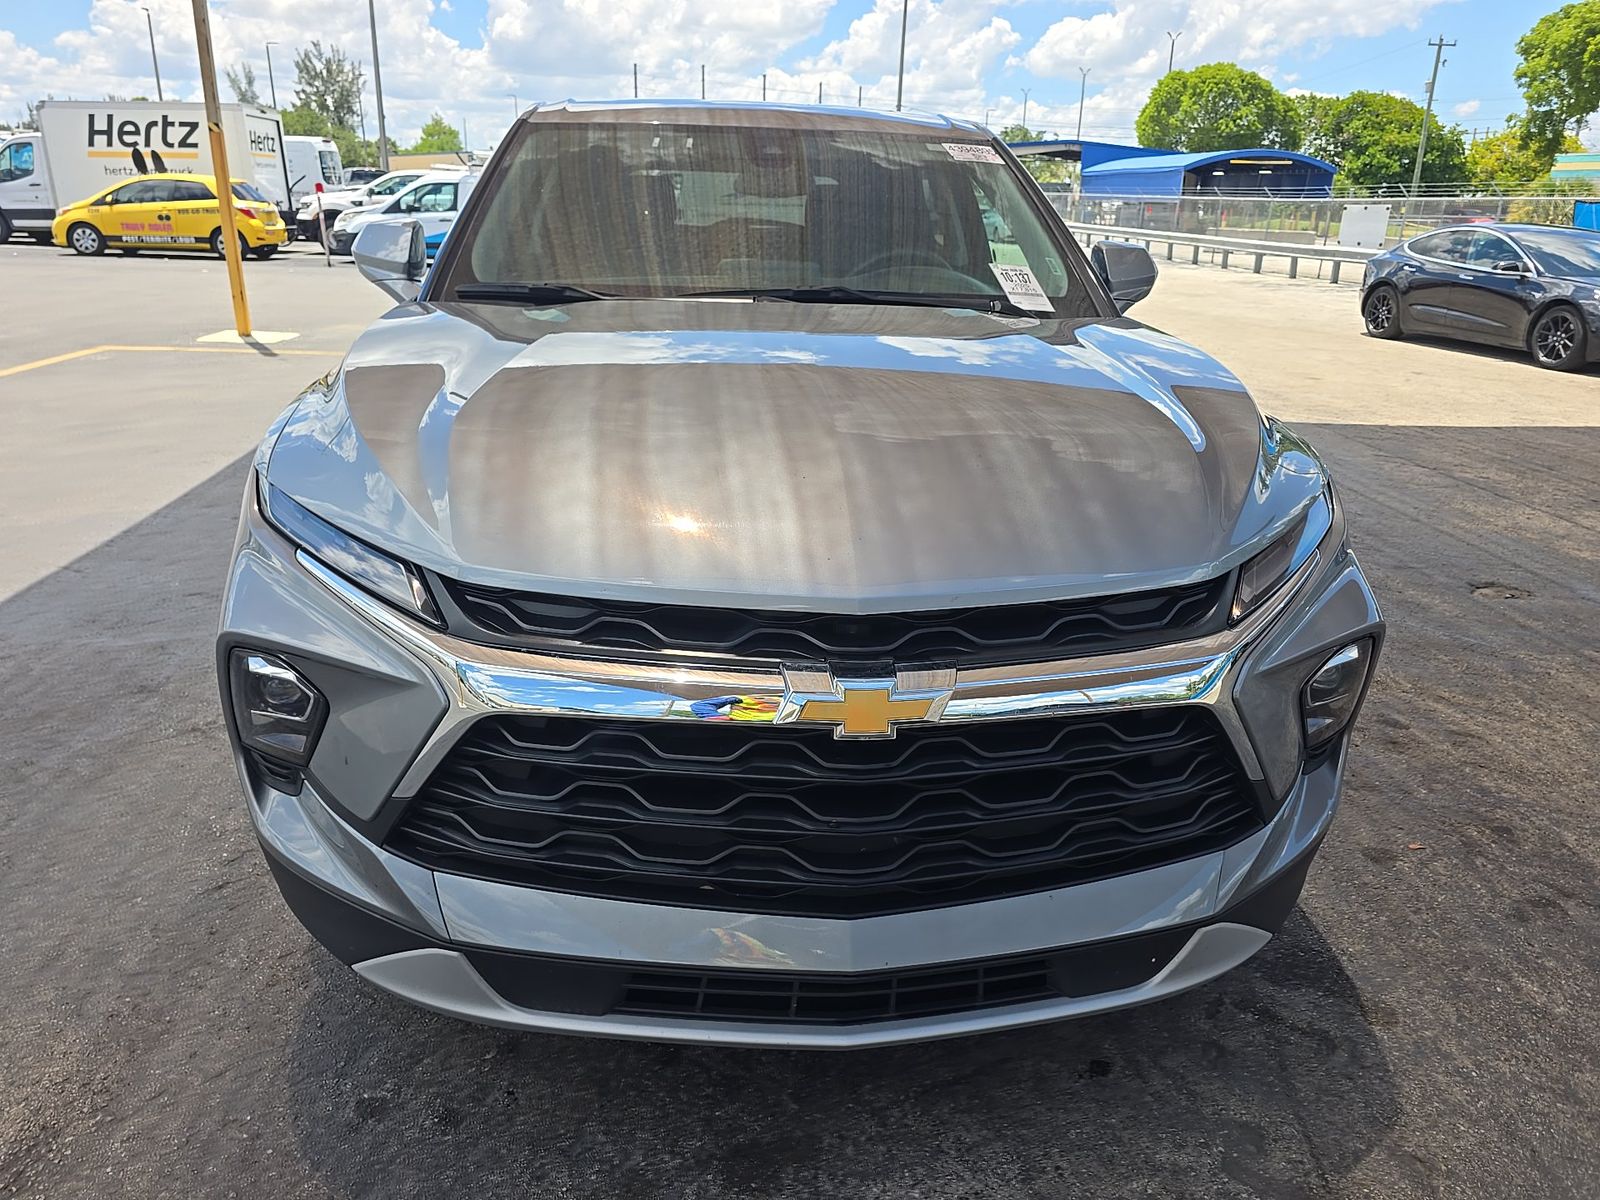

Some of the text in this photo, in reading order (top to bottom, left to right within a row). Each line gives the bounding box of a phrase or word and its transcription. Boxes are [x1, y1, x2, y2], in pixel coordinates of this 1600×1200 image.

[88, 113, 199, 148] Hertz
[249, 130, 276, 152] Hertz
[1000, 272, 1032, 284] 10:137
